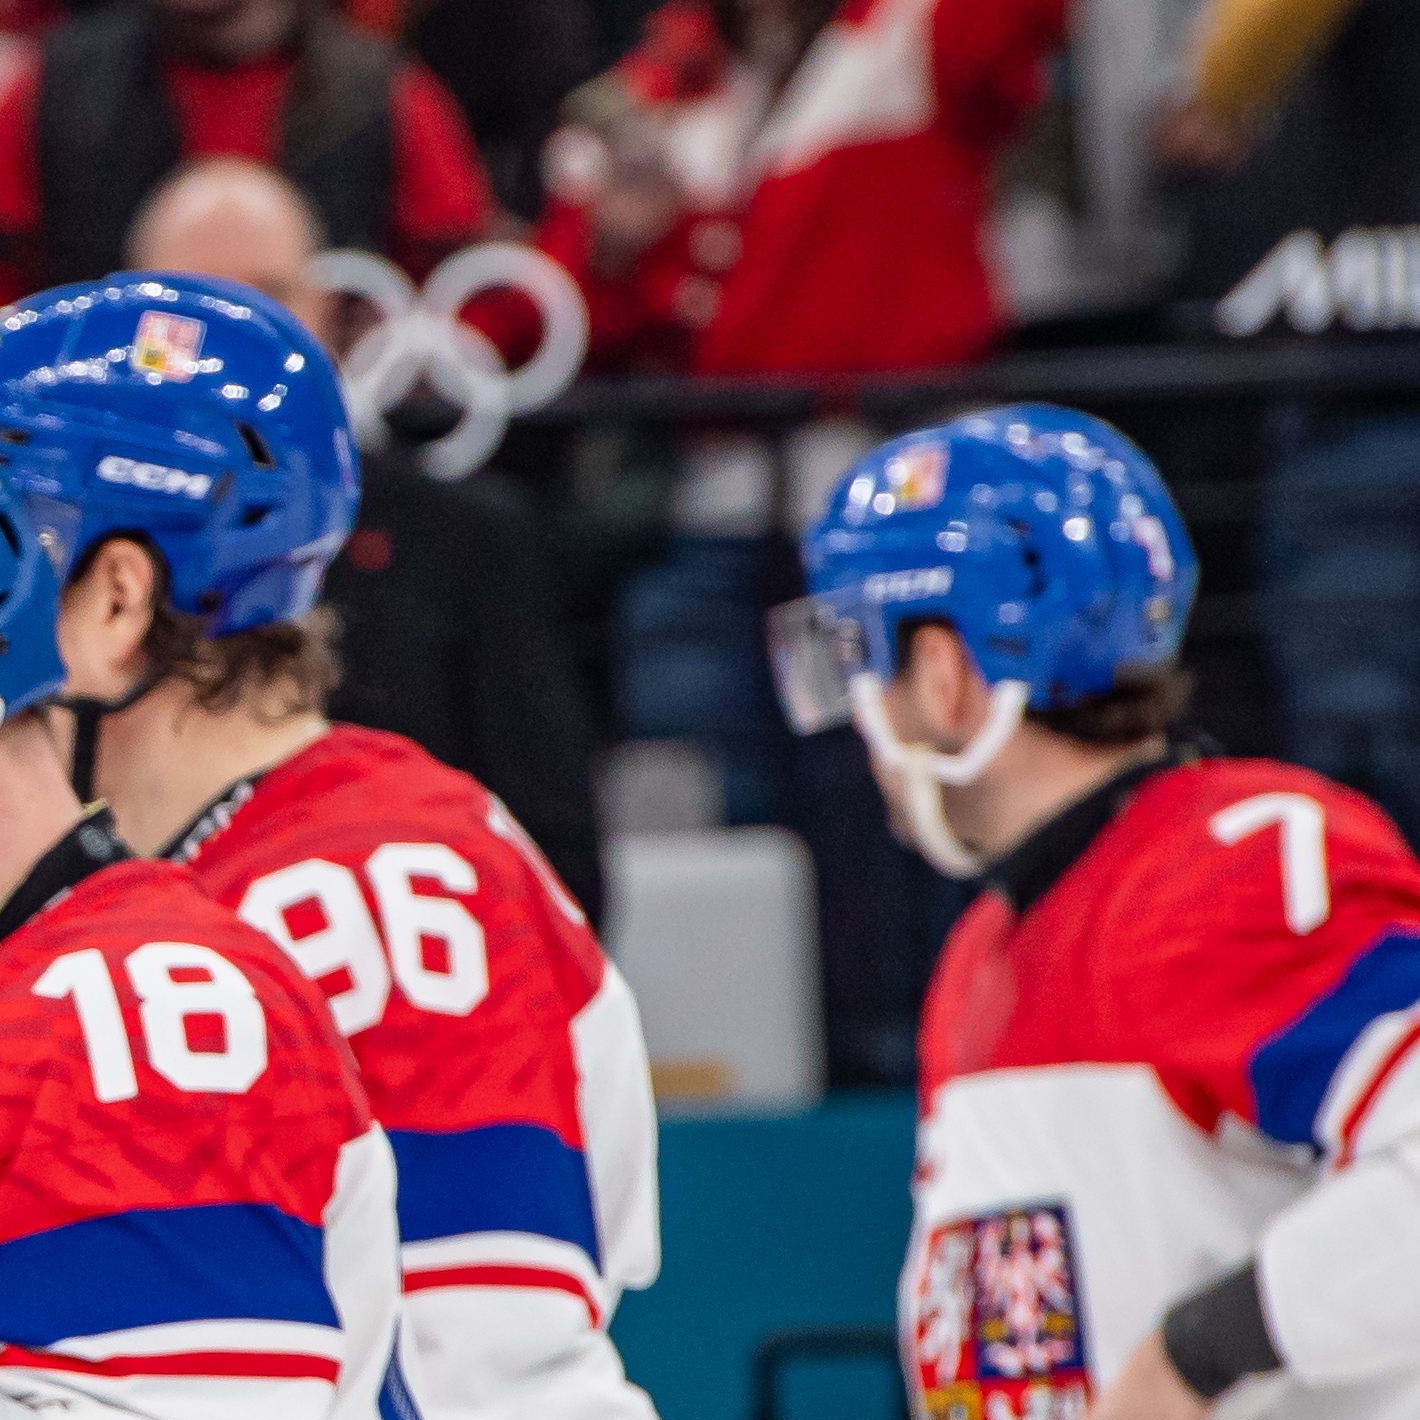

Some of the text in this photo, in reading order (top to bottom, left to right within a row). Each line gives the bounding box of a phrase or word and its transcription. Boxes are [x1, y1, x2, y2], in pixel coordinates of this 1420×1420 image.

[238, 842, 489, 1038] 96
[1210, 793, 1330, 935] 7
[32, 942, 268, 1103] 18
